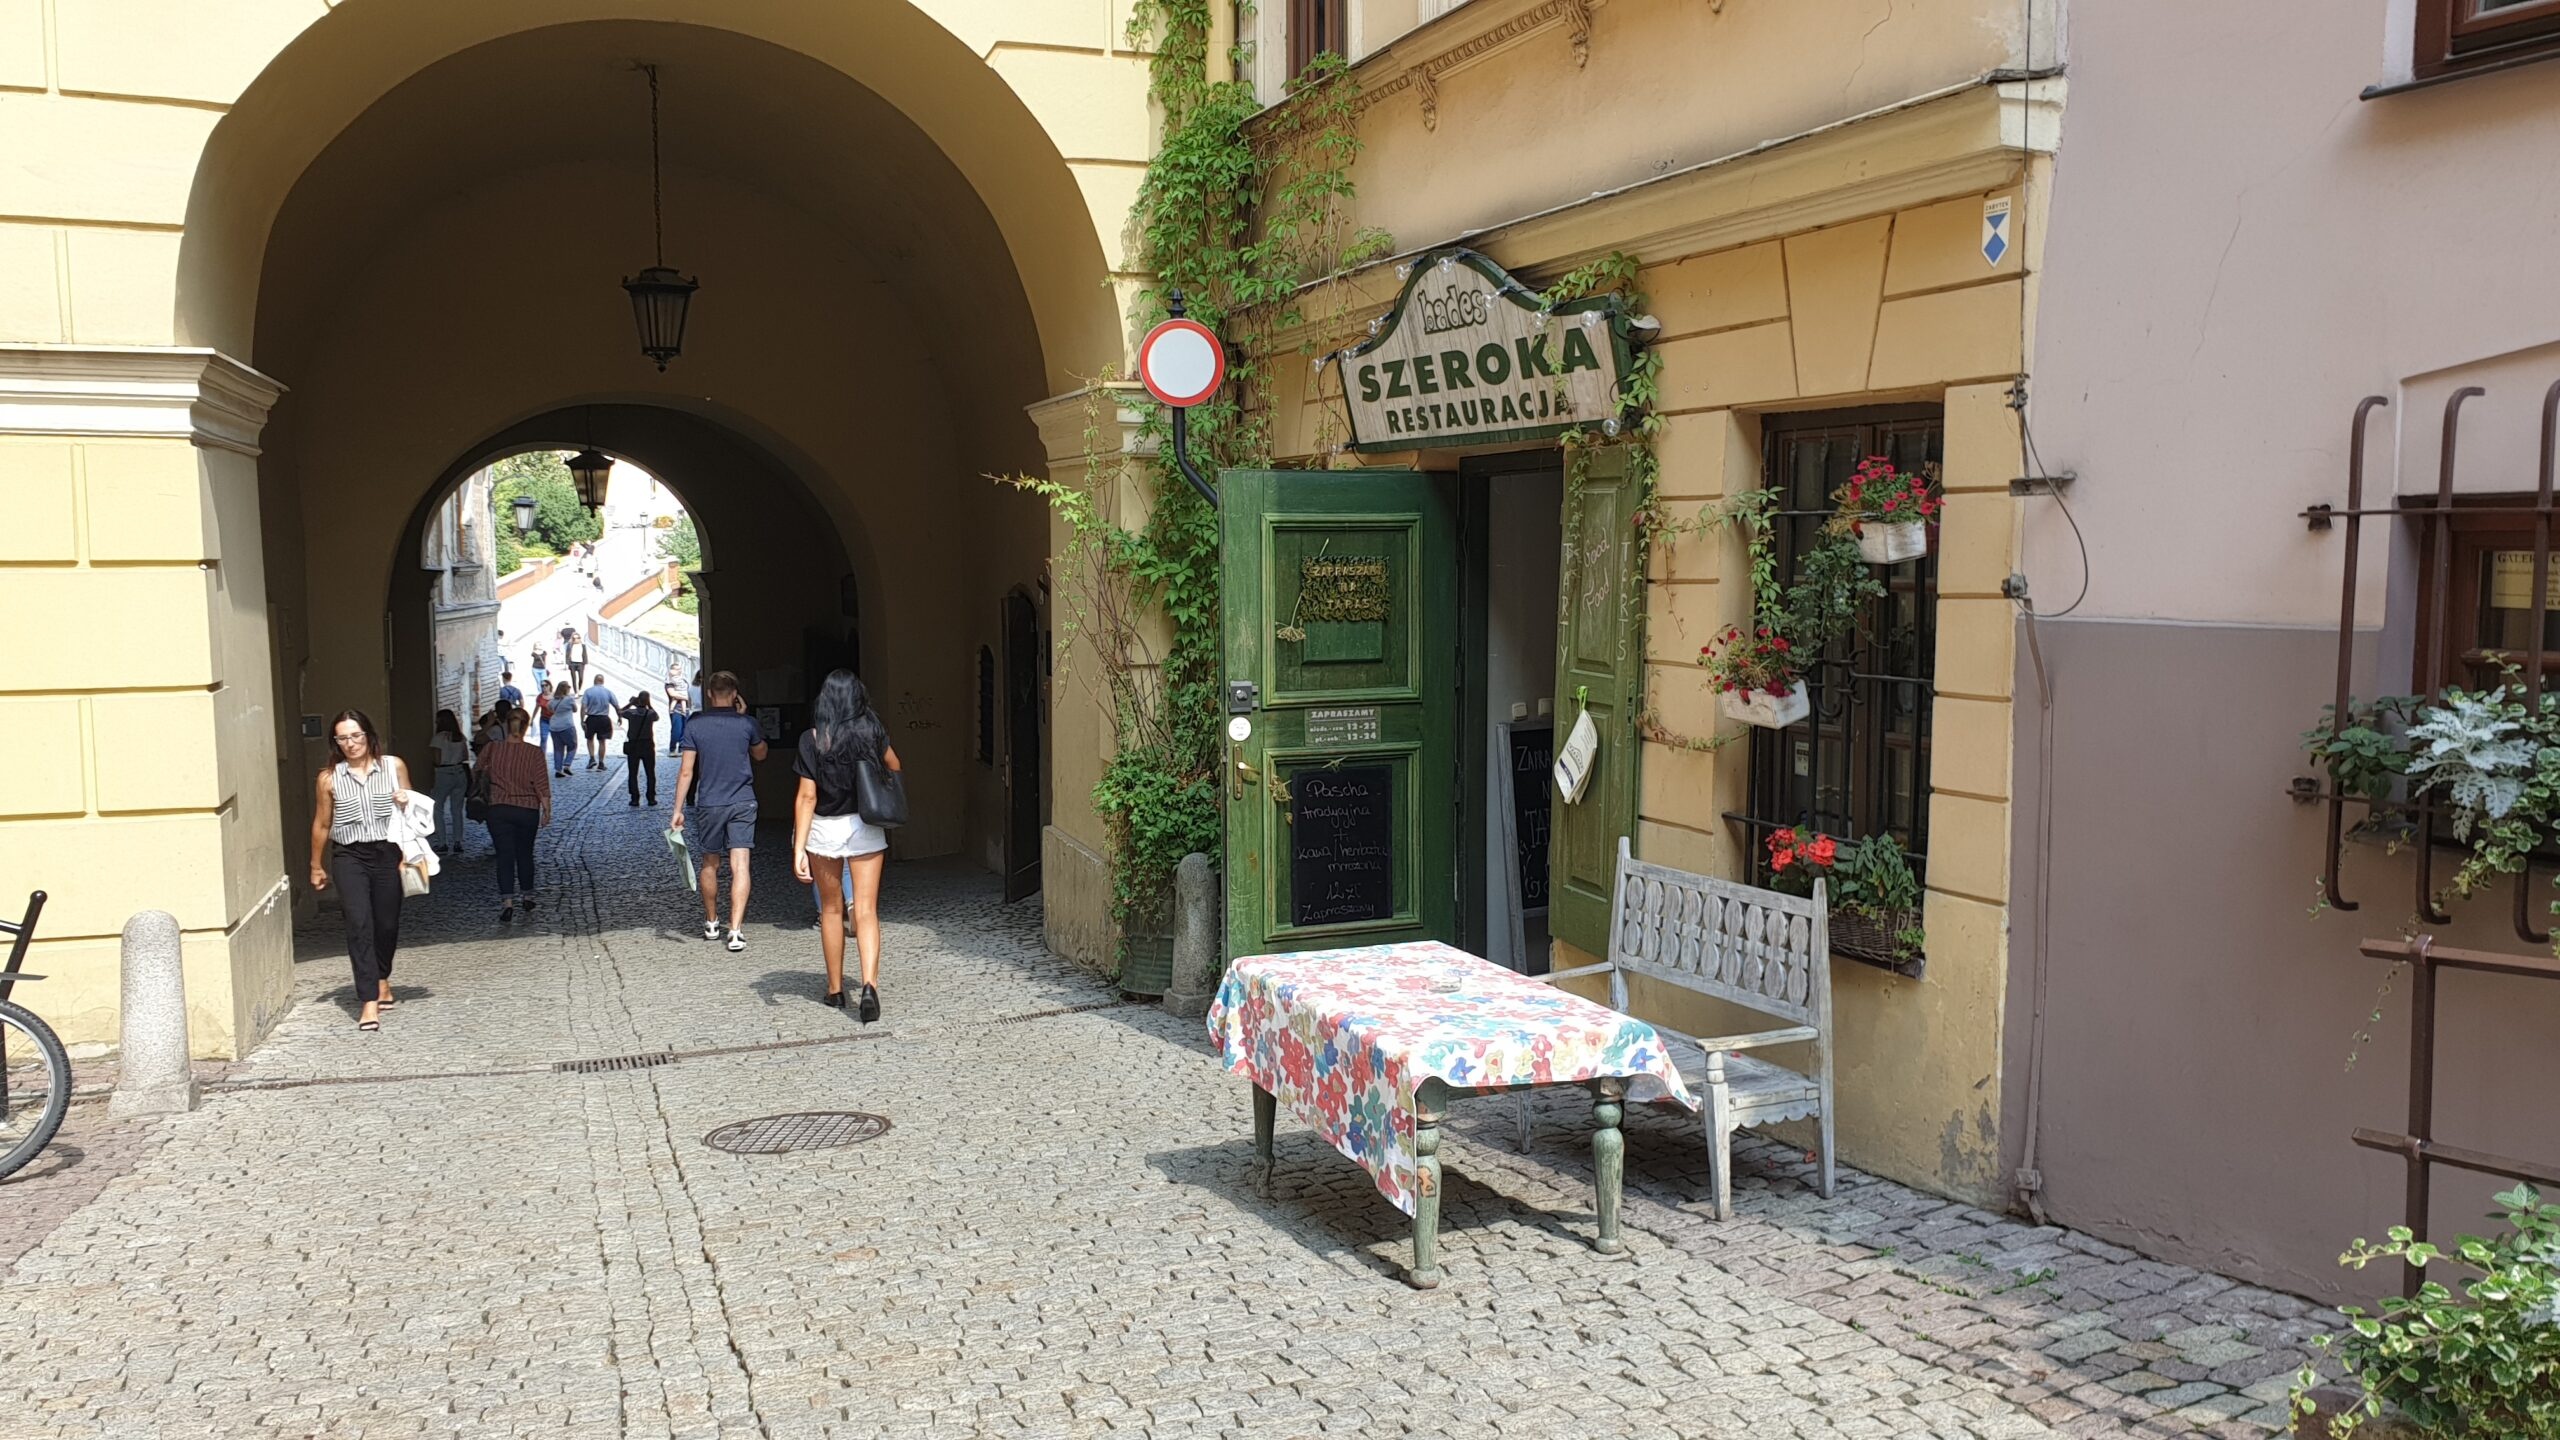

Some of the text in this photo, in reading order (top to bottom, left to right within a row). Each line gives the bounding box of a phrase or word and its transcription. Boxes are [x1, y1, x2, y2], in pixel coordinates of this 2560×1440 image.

[1418, 284, 1487, 334] hades
[1357, 327, 1601, 402] SZEROKA
[1311, 709, 1375, 718] ZAPRASZAMY
[1347, 722, 1376, 730] 12-22
[1306, 780, 1369, 797] Pascha
